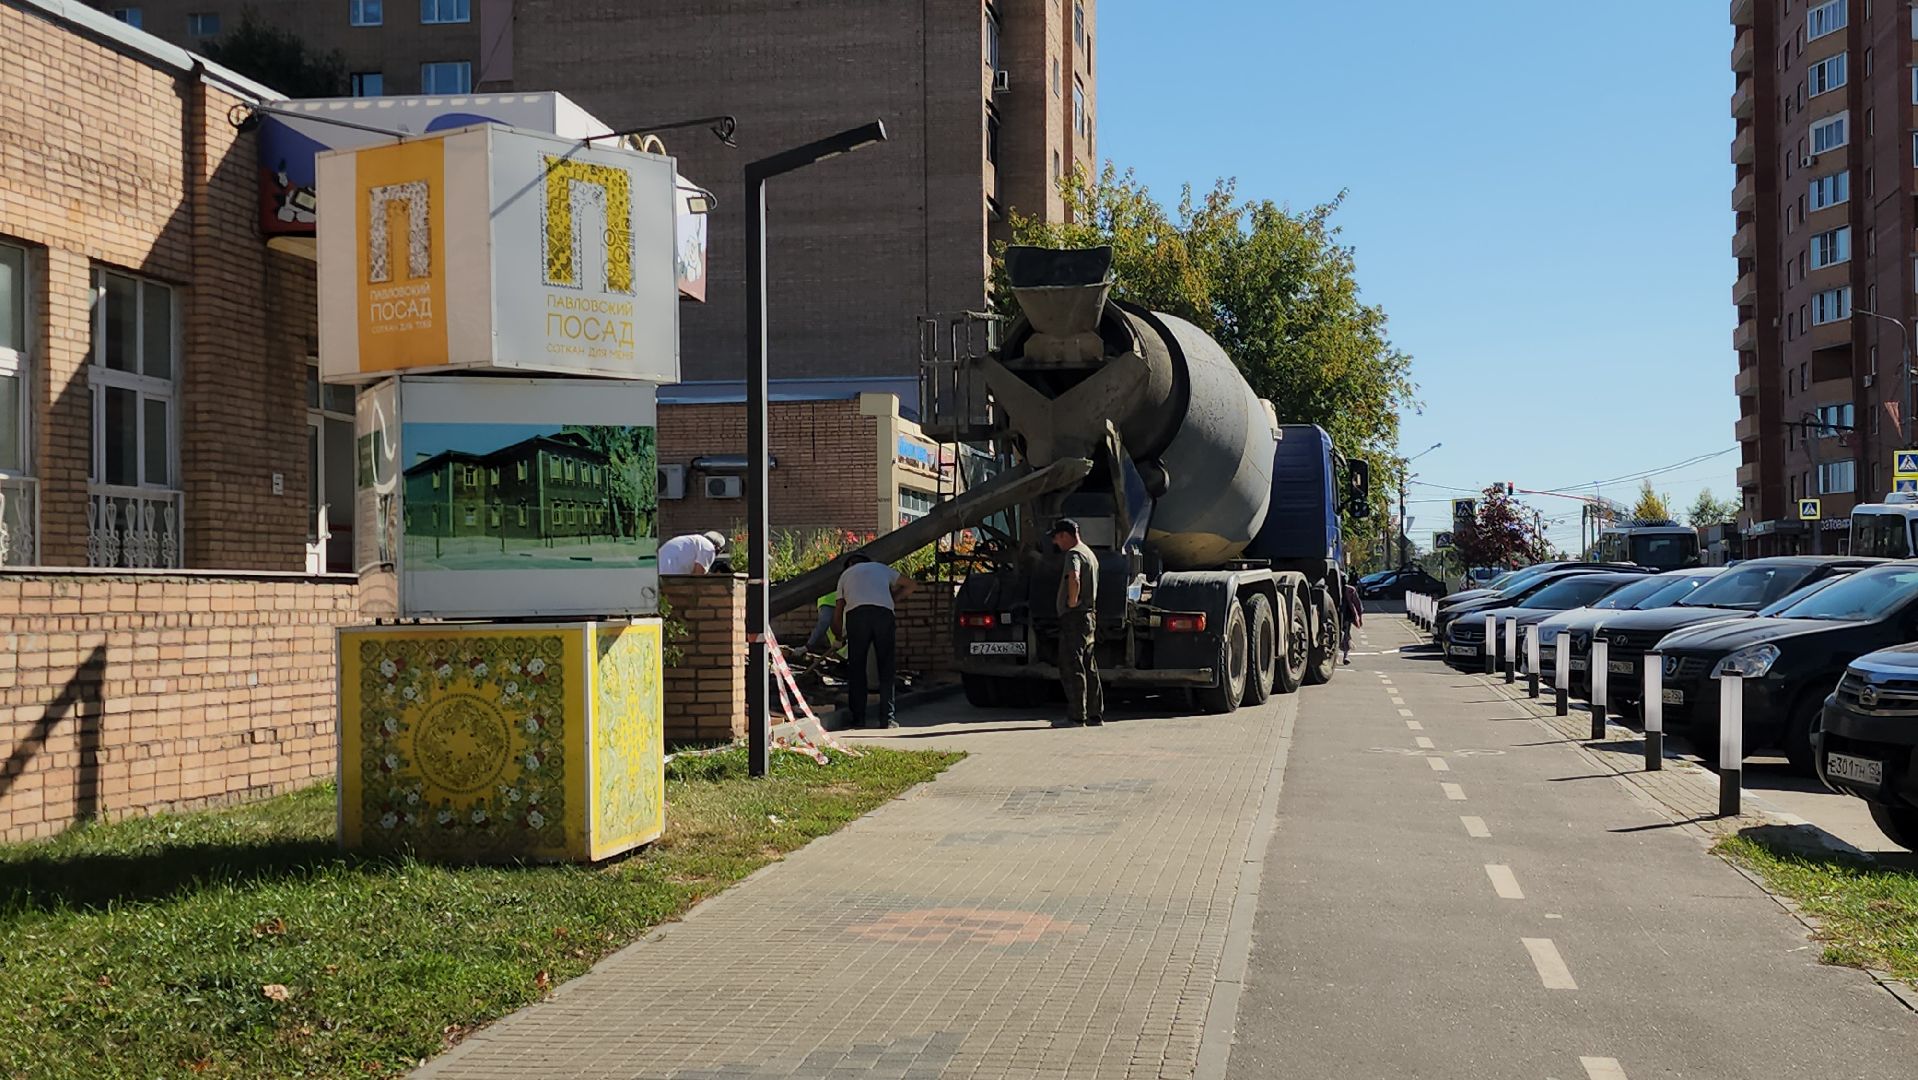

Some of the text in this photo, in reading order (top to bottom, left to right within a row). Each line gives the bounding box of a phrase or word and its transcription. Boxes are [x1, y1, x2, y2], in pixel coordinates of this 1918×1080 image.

[368, 179, 432, 284] П
[370, 281, 430, 300] ПАВЛОВСКИЙ
[370, 297, 432, 321] ПОСАД
[547, 294, 634, 316] ПАВЛОВСКИЙ
[547, 313, 635, 350] ПОСАД
[546, 343, 585, 354] СОТКАН
[587, 347, 608, 358] ДЛЯ
